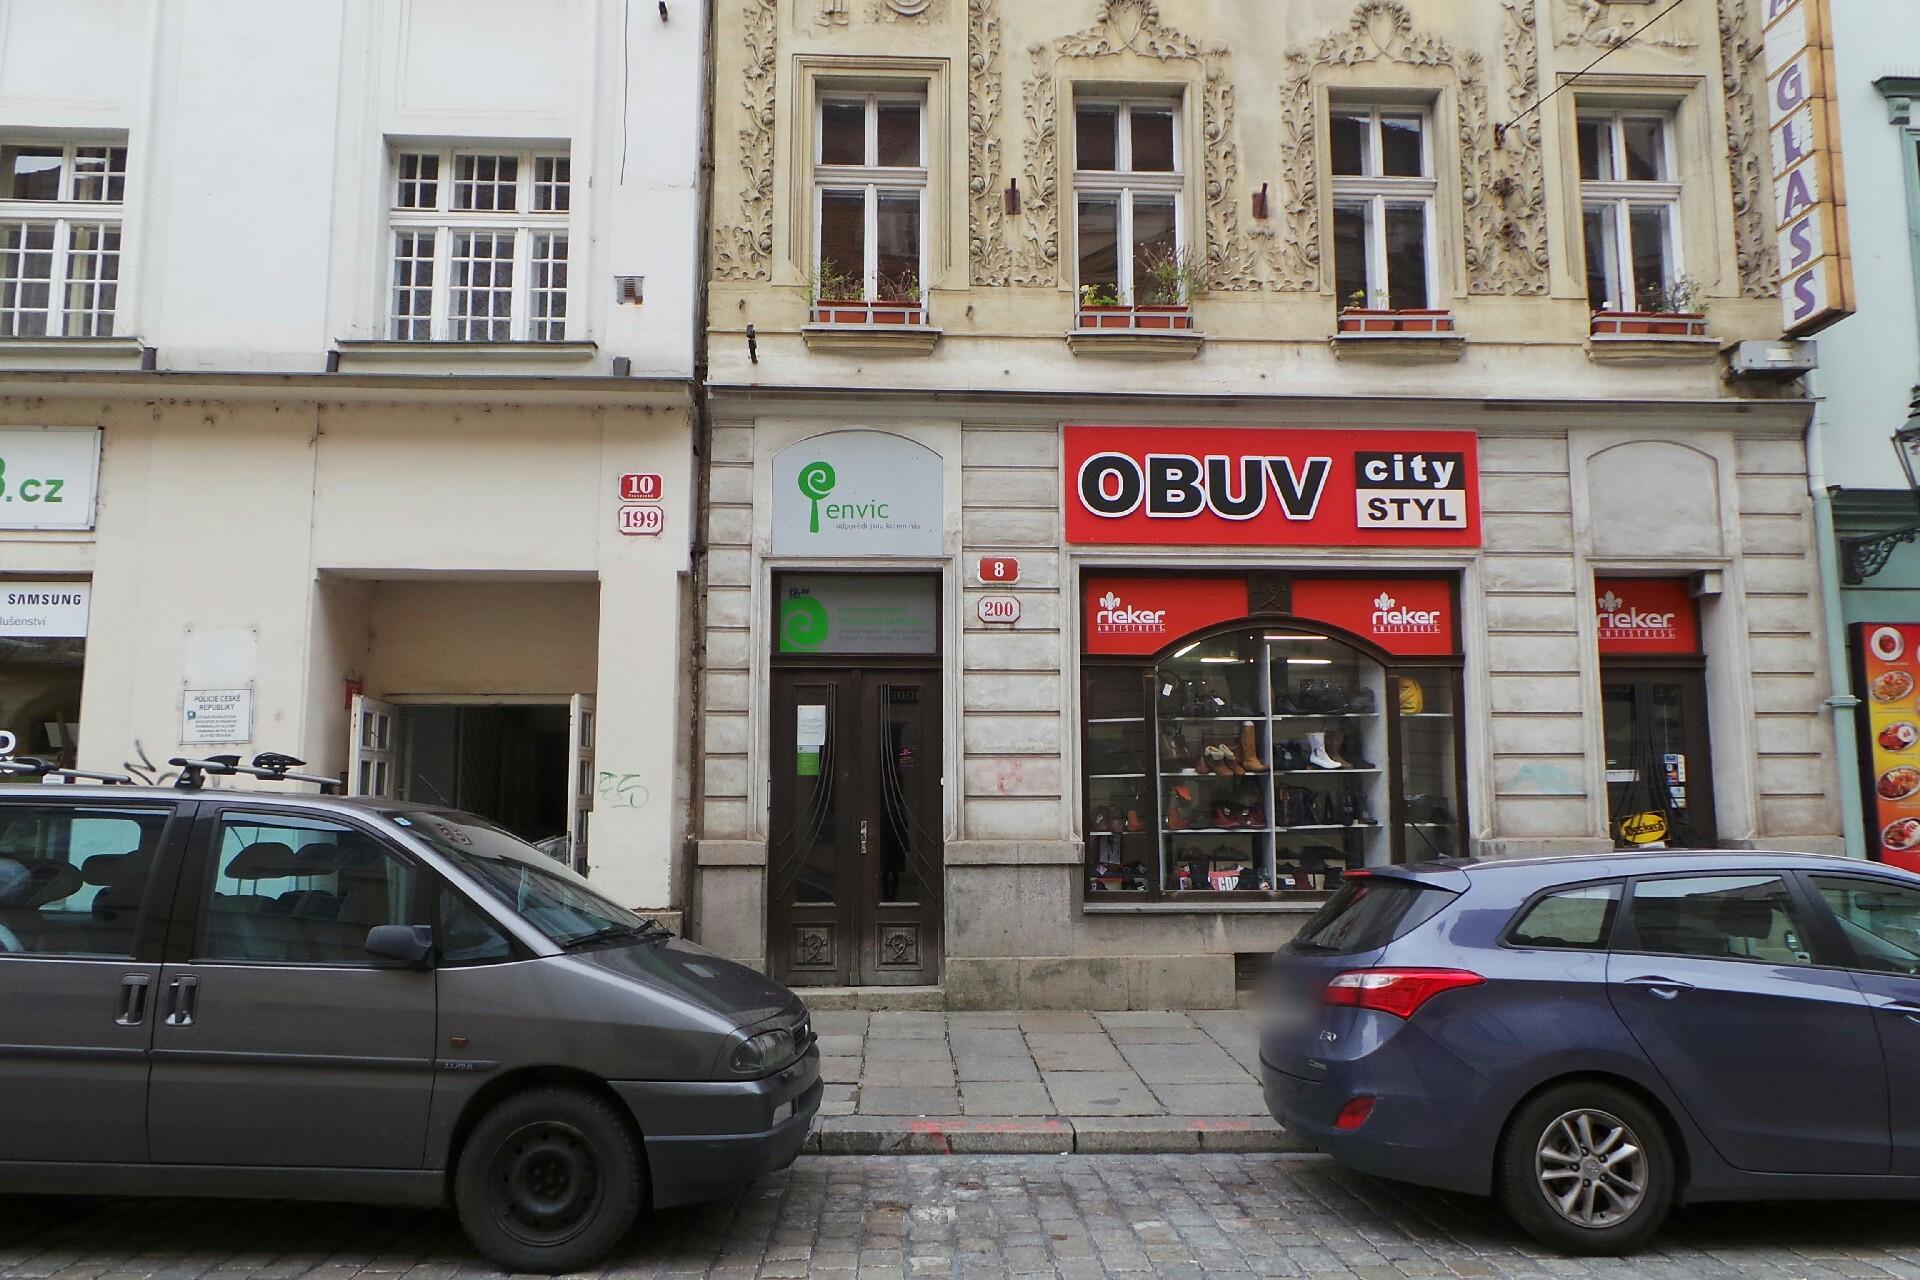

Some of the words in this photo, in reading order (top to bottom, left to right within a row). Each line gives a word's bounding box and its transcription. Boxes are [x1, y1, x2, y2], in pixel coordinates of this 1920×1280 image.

[1777, 63, 1817, 321] GLASS
[1364, 454, 1455, 489] city
[629, 476, 654, 494] 10
[1078, 452, 1332, 521] OBUV
[826, 499, 889, 519] envic
[1367, 497, 1457, 522] STYL
[623, 511, 659, 528] 199
[993, 561, 1005, 577] 8
[8, 593, 82, 605] SAMSUNG
[984, 601, 1014, 617] 200
[1097, 604, 1166, 624] rieker
[1372, 605, 1440, 625] rieker
[1597, 607, 1675, 628] rieker
